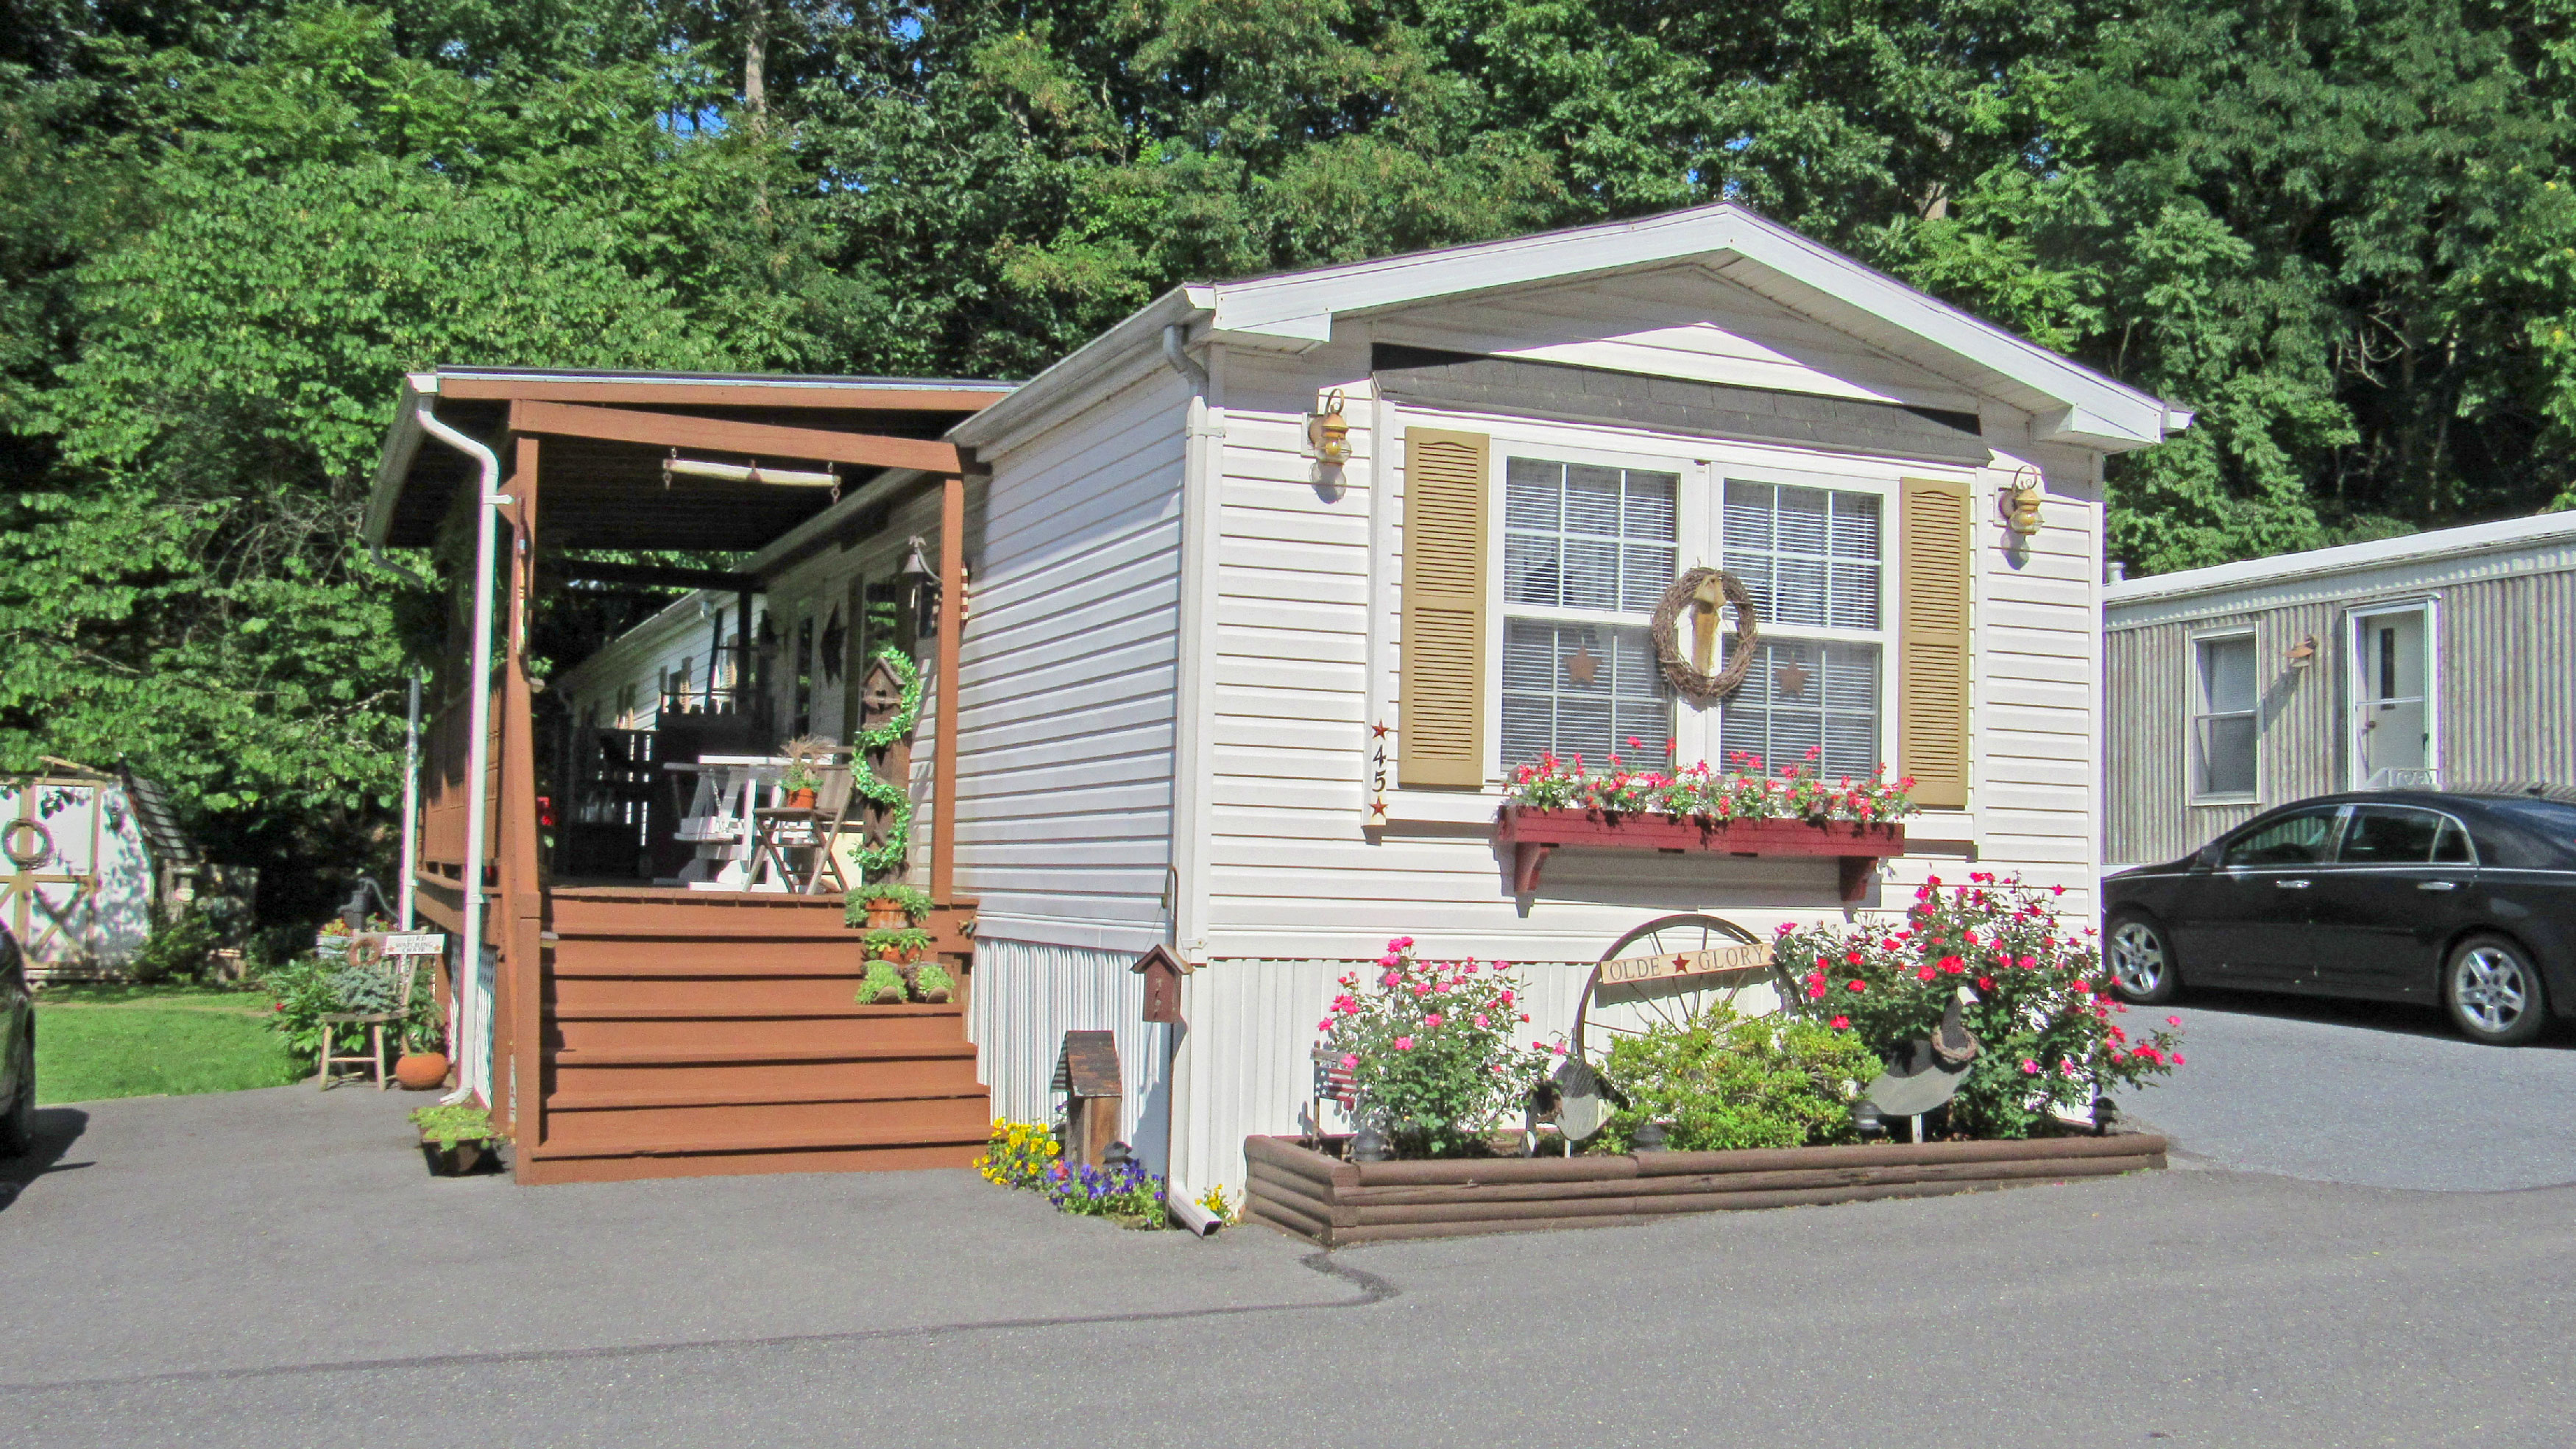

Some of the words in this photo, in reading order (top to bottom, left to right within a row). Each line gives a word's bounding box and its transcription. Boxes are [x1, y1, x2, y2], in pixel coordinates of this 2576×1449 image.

[1372, 744, 1387, 792] 45
[1610, 957, 1661, 980] OLDE
[1698, 946, 1763, 970] GLORY
